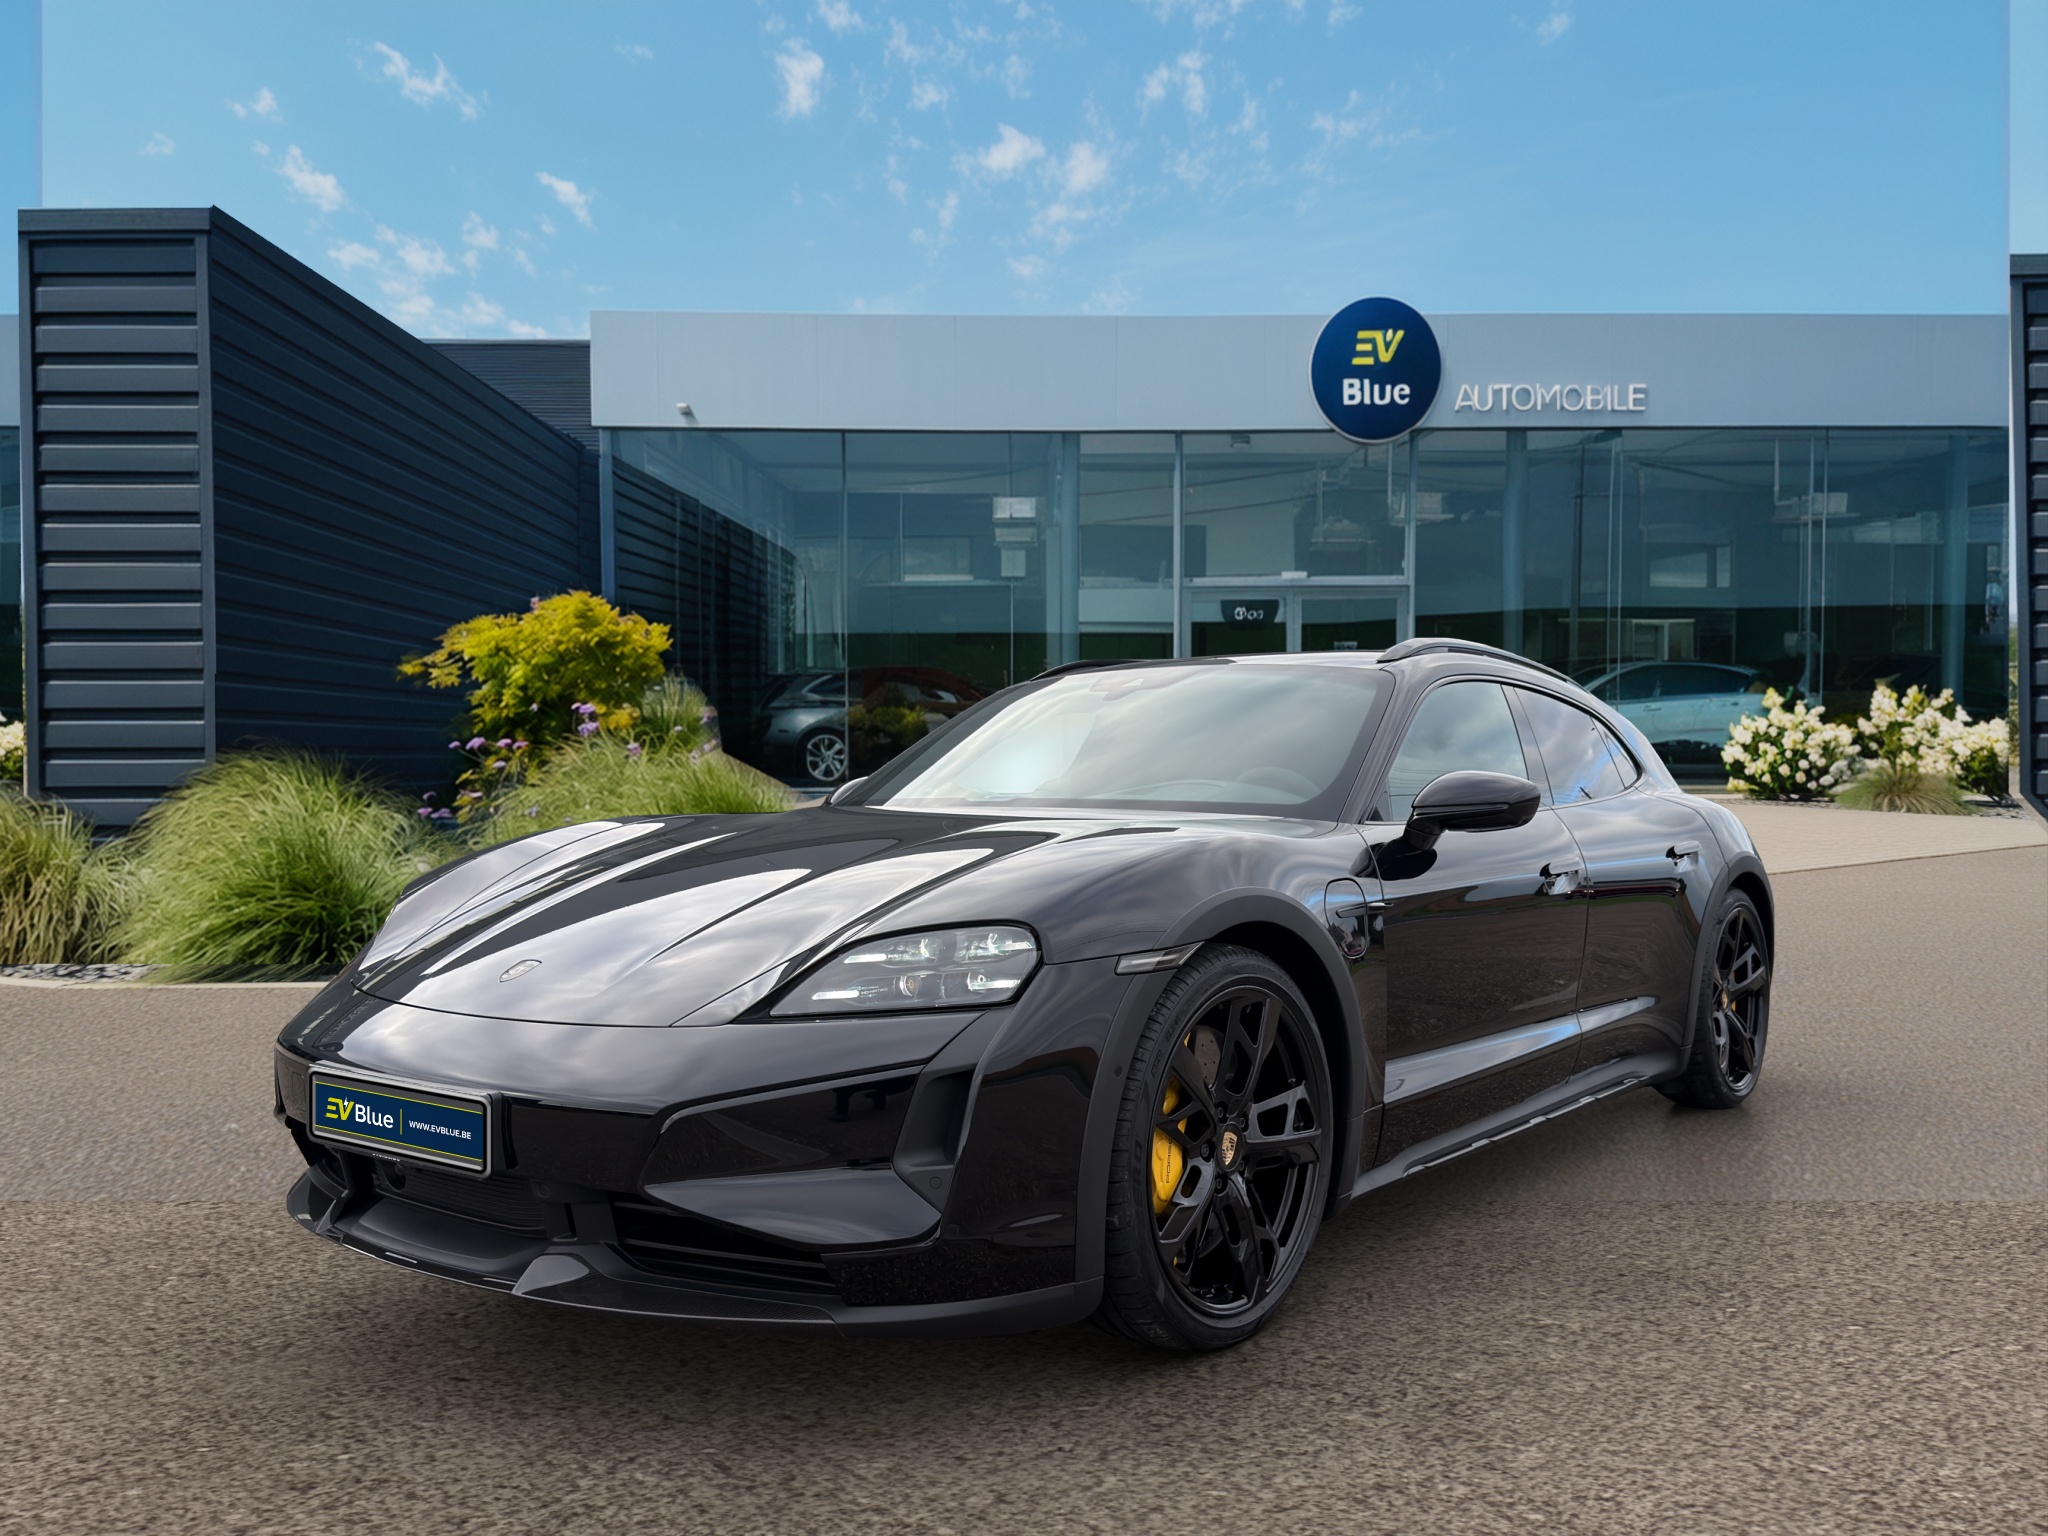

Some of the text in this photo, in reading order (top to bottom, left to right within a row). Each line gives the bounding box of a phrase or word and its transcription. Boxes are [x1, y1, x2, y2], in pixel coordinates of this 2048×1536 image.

[1352, 328, 1405, 365] EV
[1342, 378, 1411, 406] Blue
[1454, 383, 1647, 412] AUTOMOBILE
[325, 1097, 471, 1139] EV Blue WWW.EVBLUE.BE
